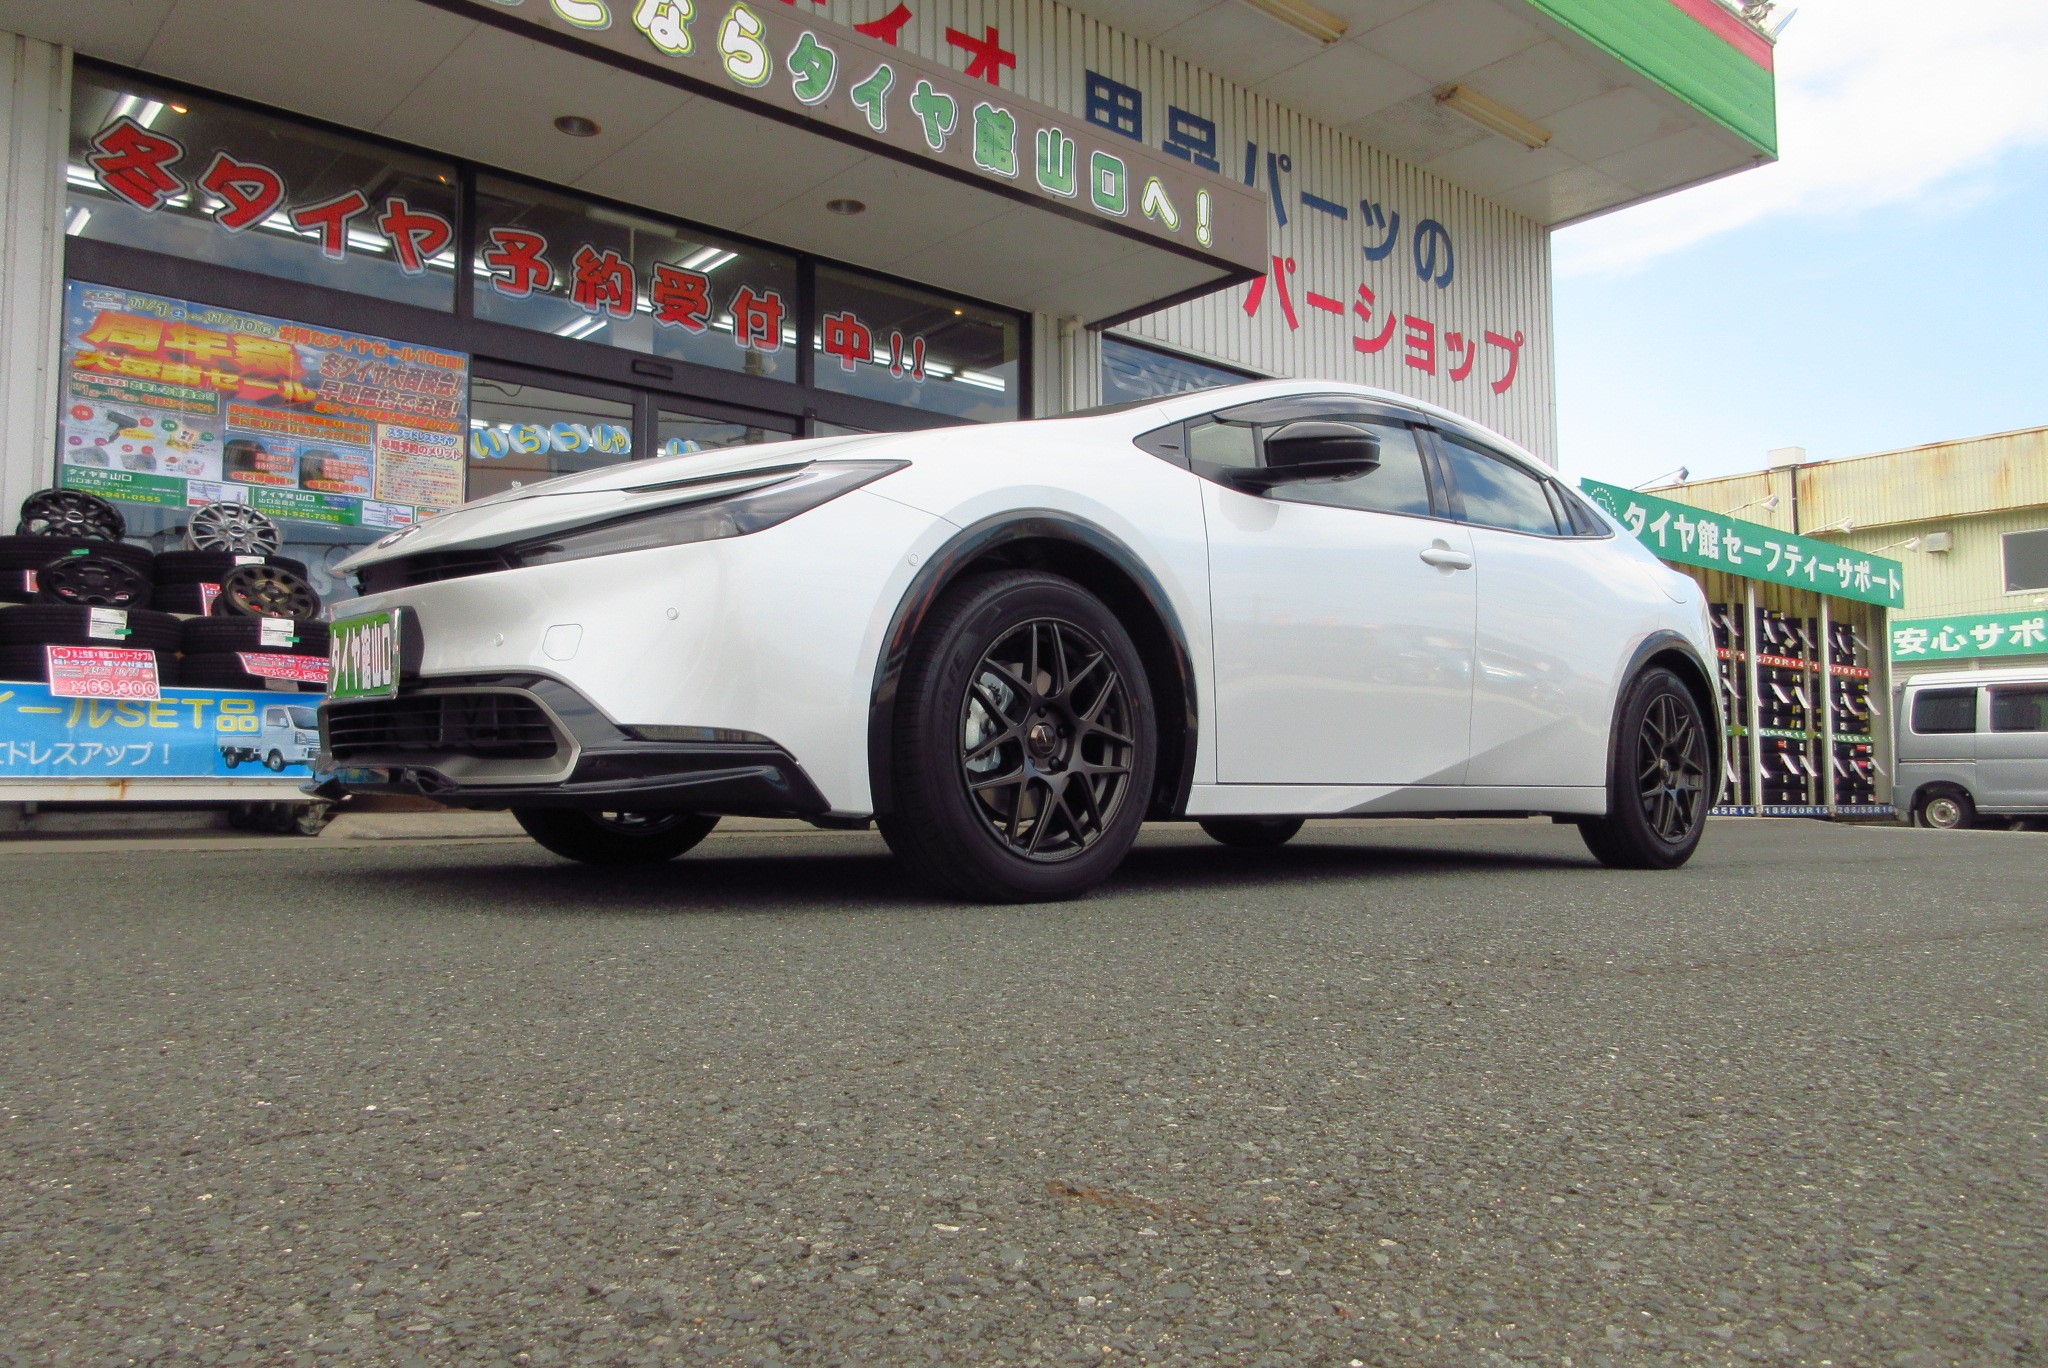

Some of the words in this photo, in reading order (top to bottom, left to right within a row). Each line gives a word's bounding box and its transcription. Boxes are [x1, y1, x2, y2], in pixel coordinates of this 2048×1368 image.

[1623, 501, 1900, 600] タイヤ館セーフティーサポート
[1893, 617, 2047, 656] 安心サポ
